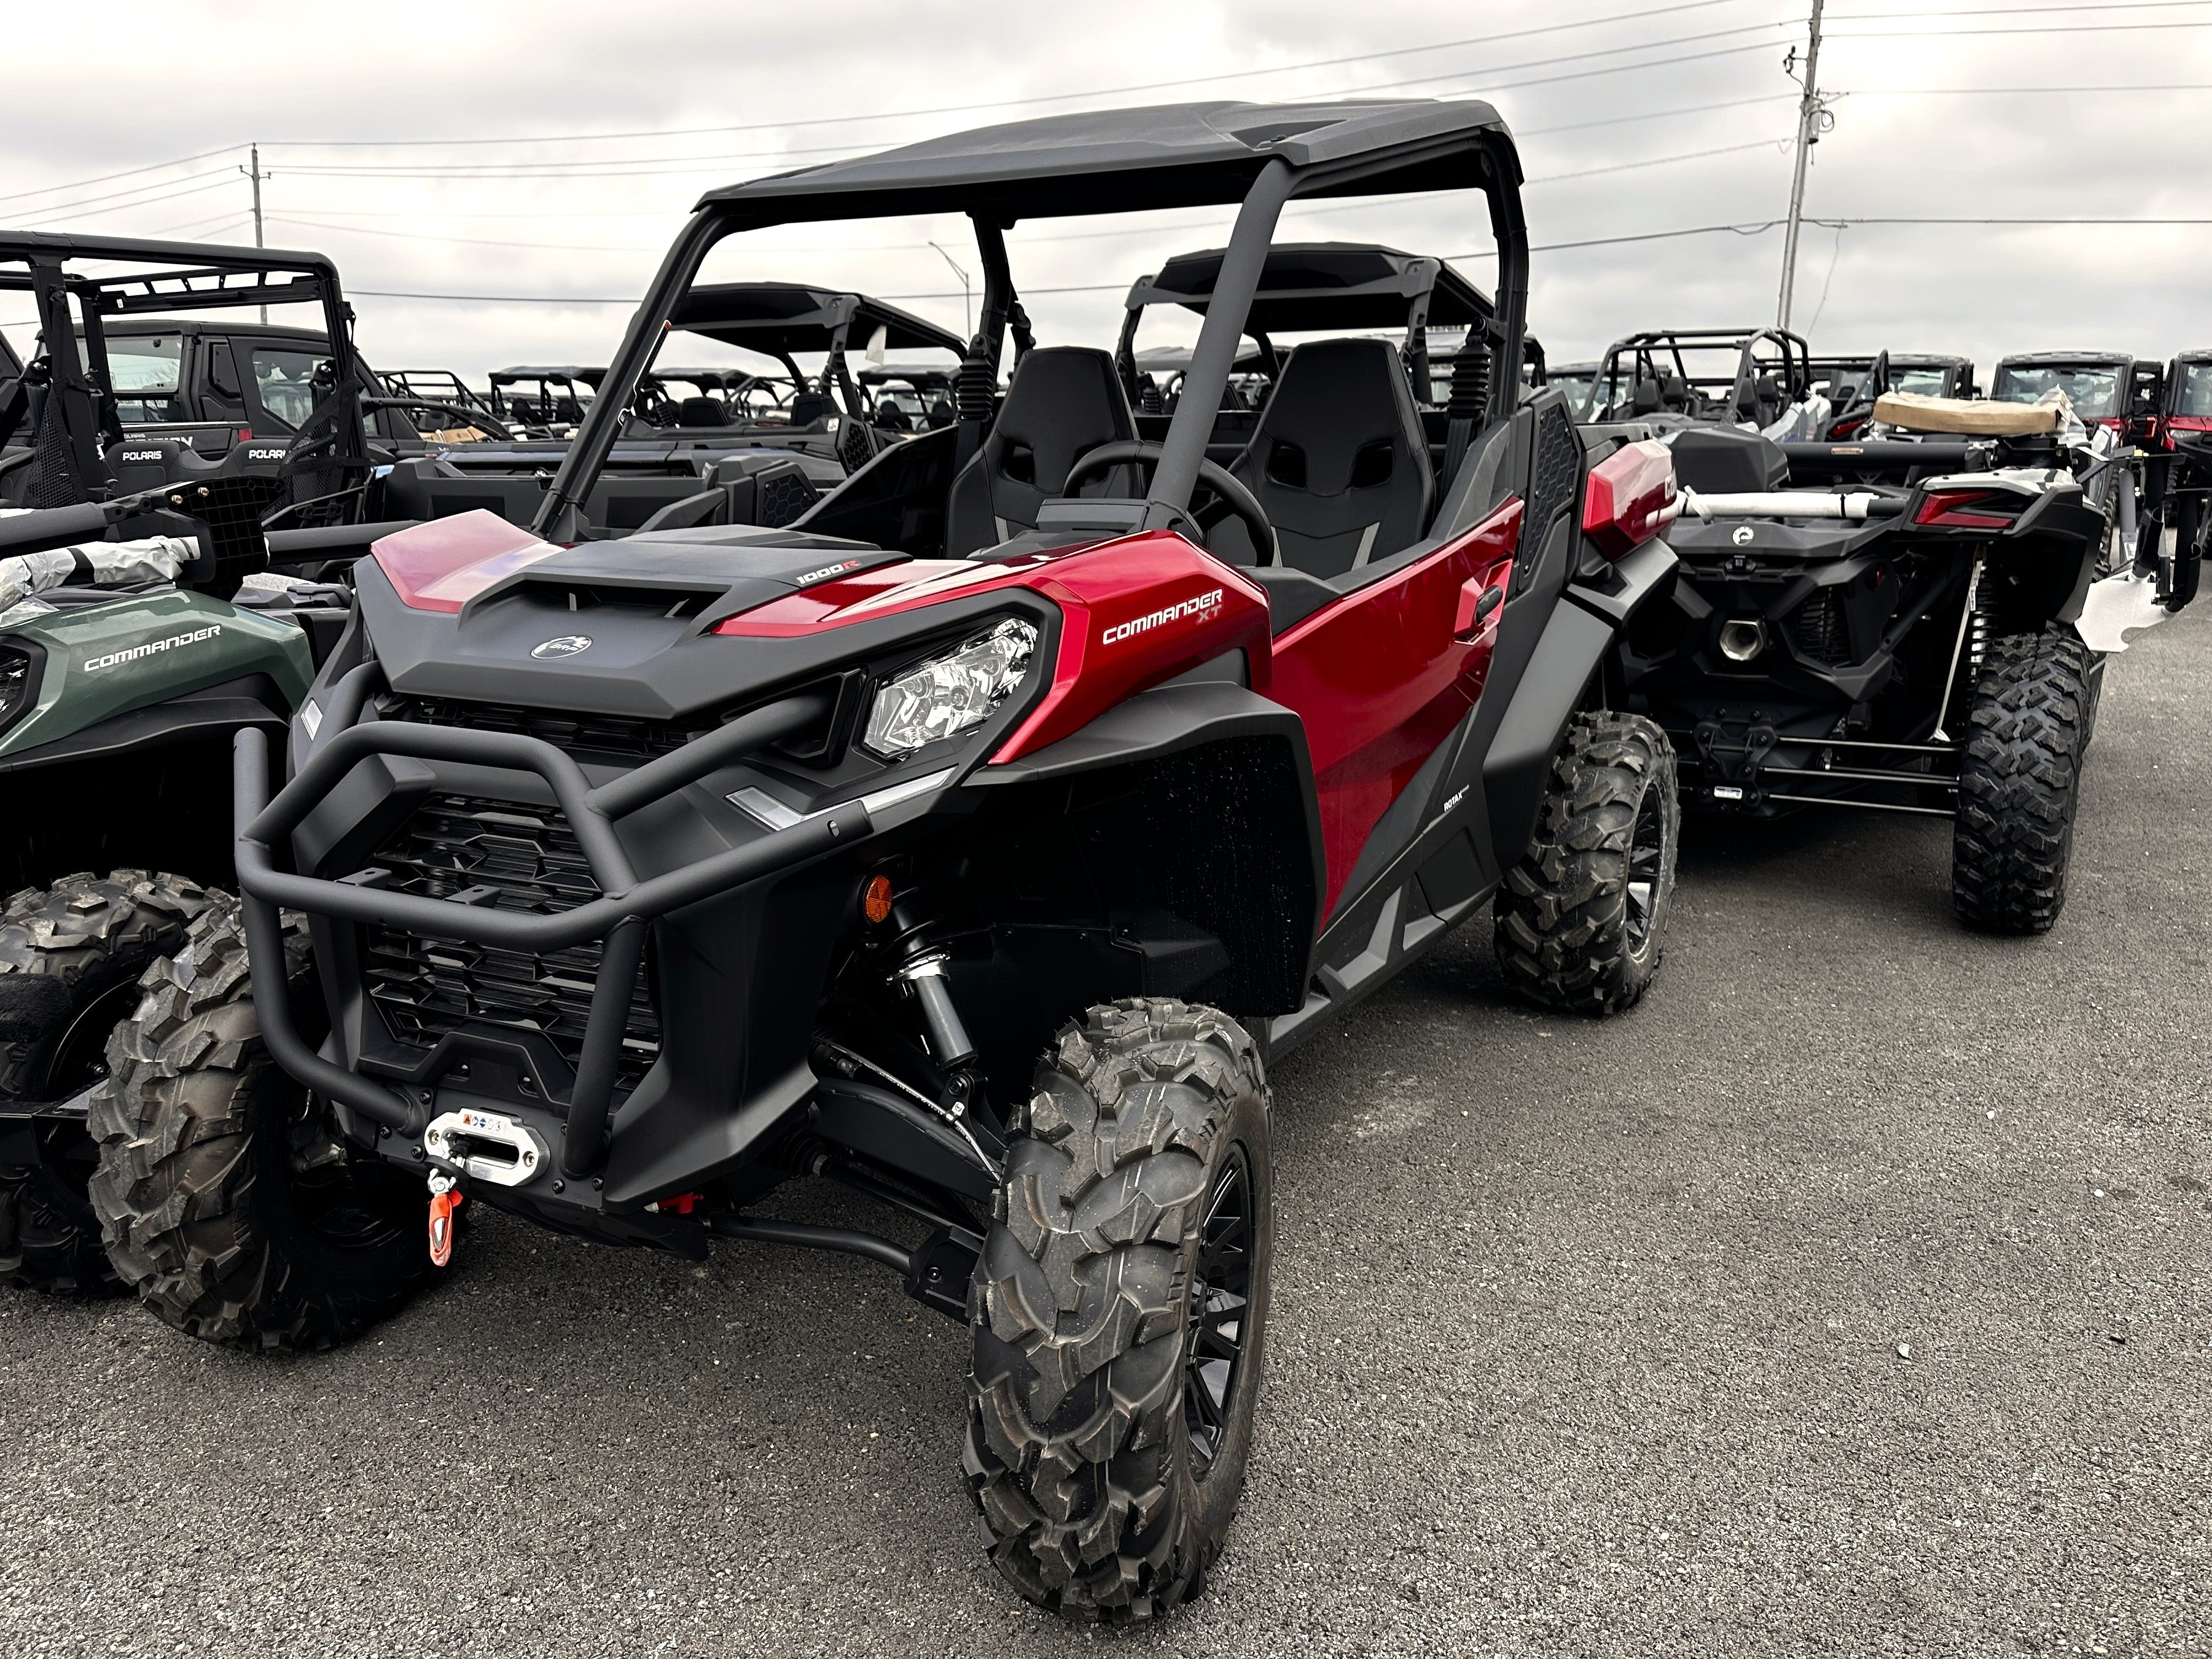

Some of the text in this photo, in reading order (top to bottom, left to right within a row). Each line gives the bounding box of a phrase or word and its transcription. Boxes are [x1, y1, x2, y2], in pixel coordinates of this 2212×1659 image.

[123, 450, 162, 461] POLARIS
[249, 449, 286, 459] POLARI
[797, 560, 860, 584] 1000R
[1103, 588, 1223, 645] COMMANDER
[1197, 604, 1222, 623] XT
[84, 624, 221, 672] COMMANDER
[1444, 790, 1463, 812] ROTAX
